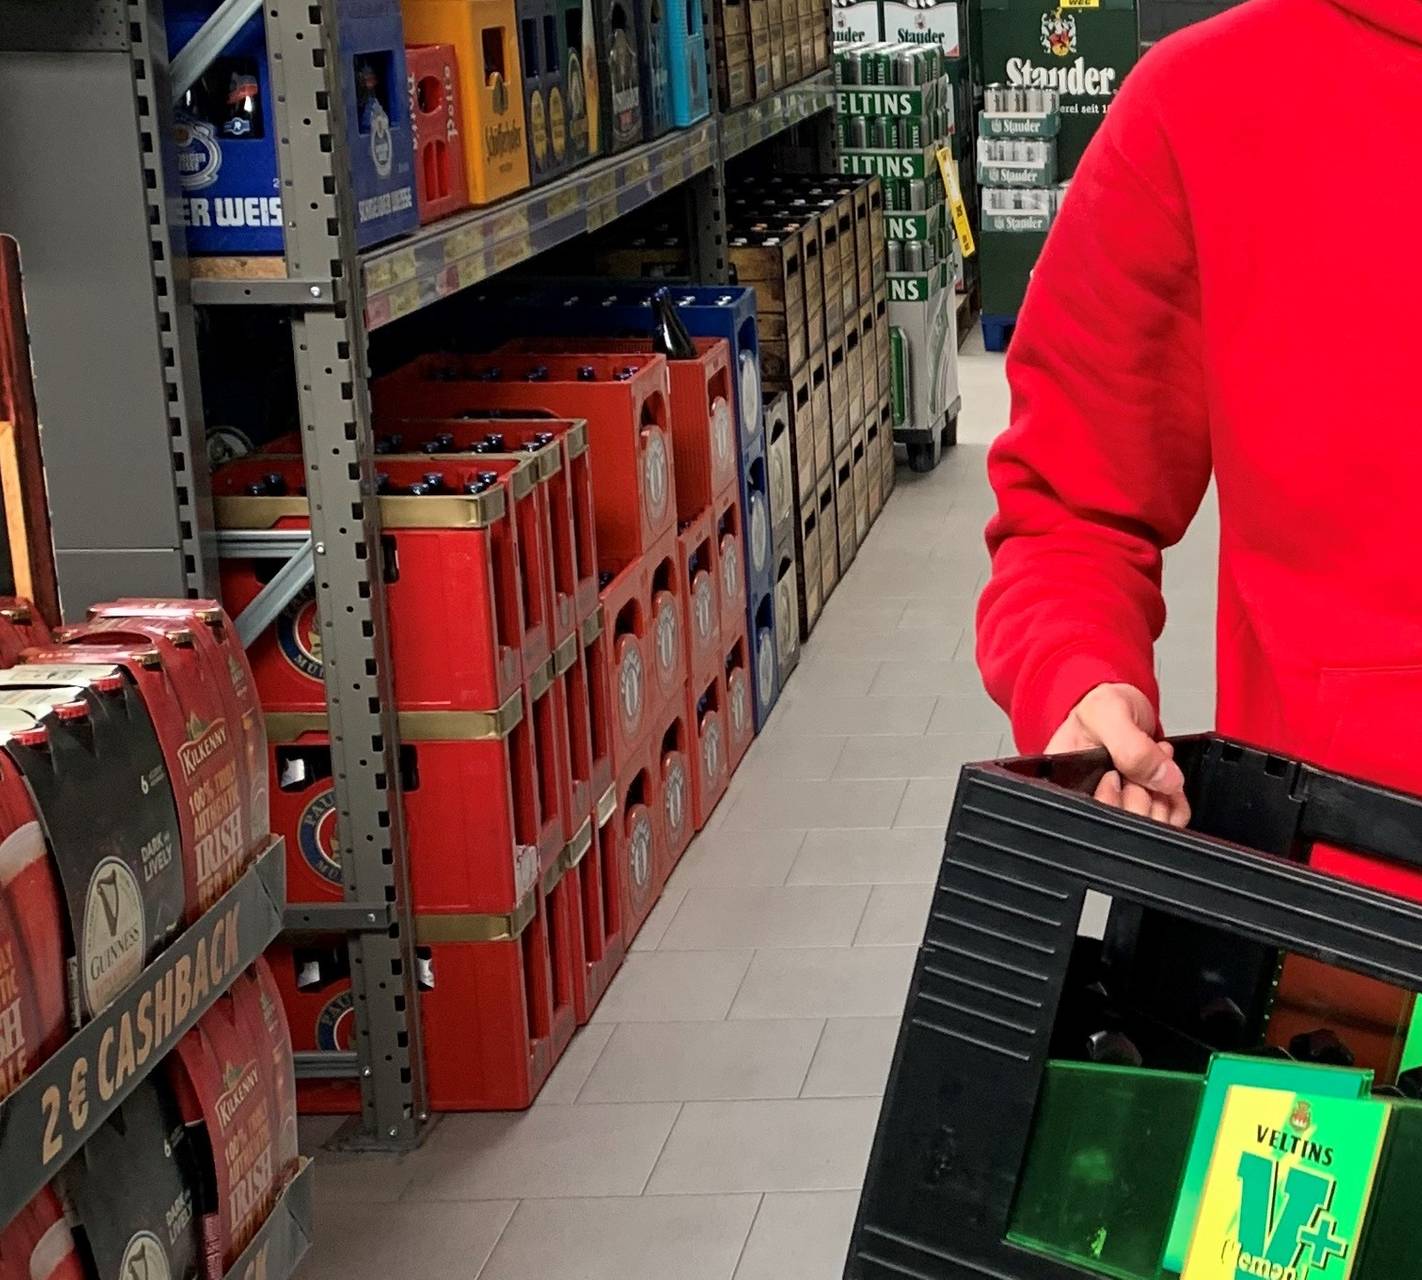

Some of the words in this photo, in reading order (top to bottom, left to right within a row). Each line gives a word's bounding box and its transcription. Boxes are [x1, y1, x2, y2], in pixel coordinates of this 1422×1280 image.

[898, 27, 945, 45] Stauder
[1006, 57, 1116, 95] Stauder
[1081, 104, 1099, 113] seit
[183, 728, 227, 776] KILKENNY
[140, 775, 149, 794] 6
[141, 831, 165, 863] DARK
[143, 844, 173, 883] LIVELY
[194, 806, 243, 887] IRISH
[42, 1085, 64, 1166] 2
[68, 1056, 89, 1131] €
[98, 902, 241, 1101] CASHBACK
[220, 1066, 259, 1127] KILKENNY
[1257, 1124, 1334, 1167] VELTINS
